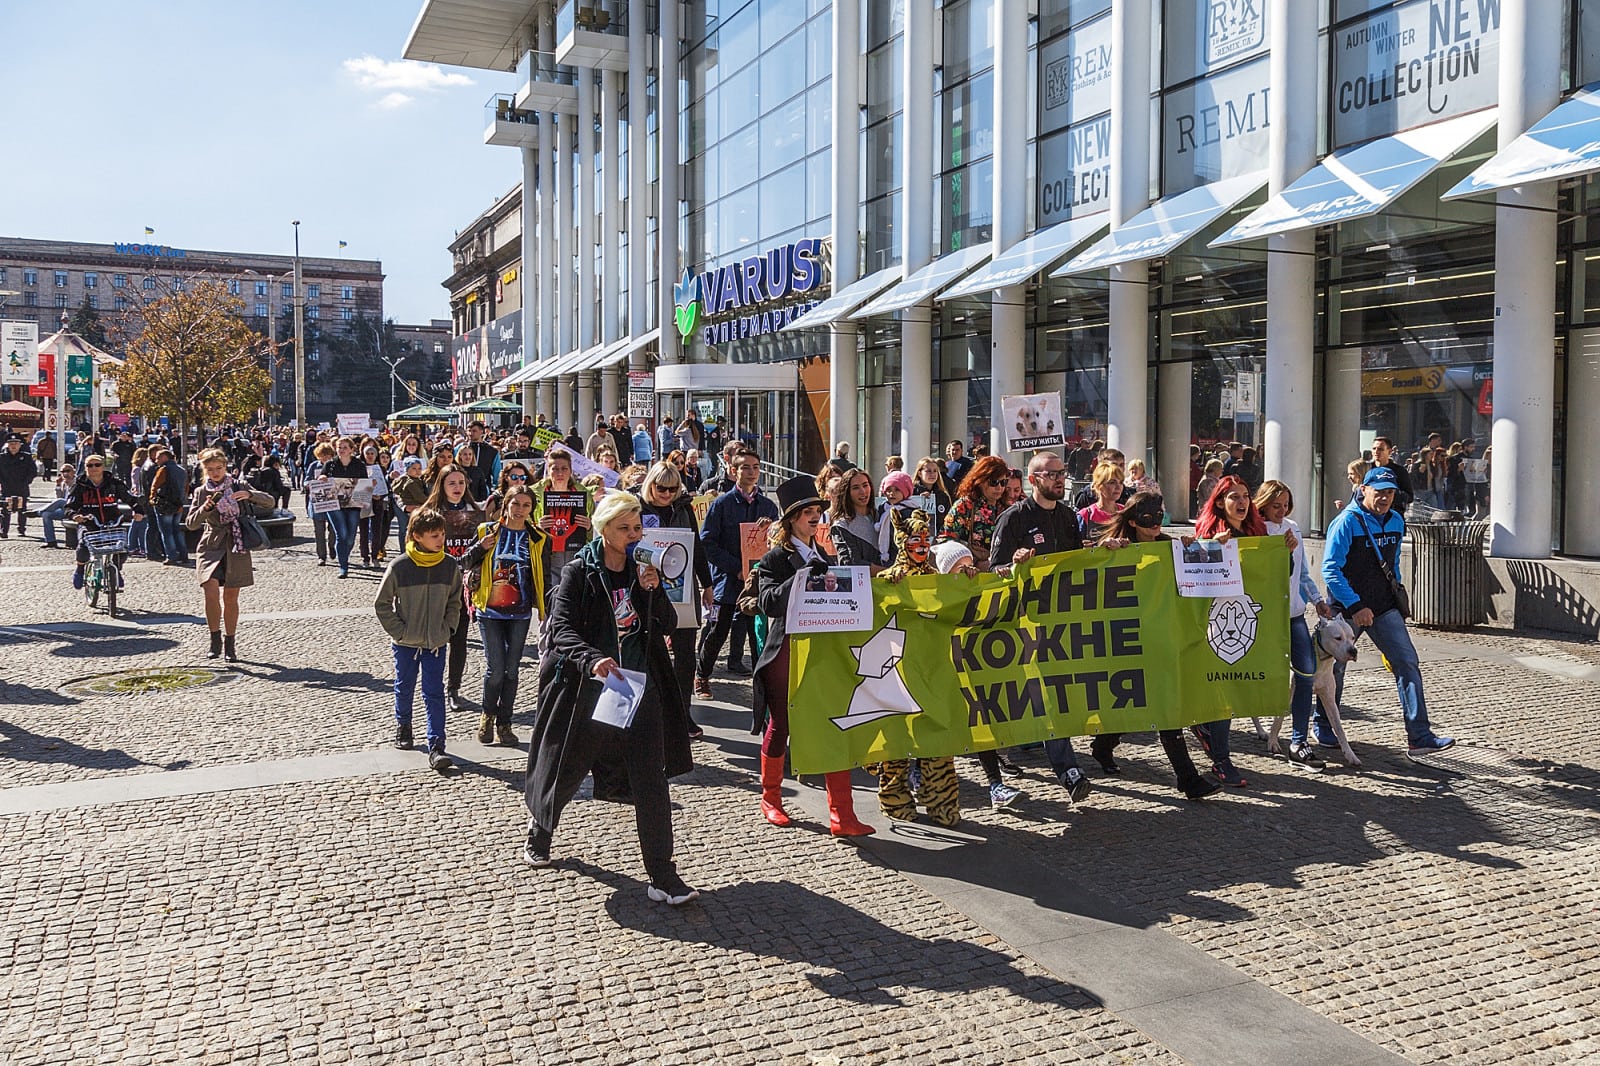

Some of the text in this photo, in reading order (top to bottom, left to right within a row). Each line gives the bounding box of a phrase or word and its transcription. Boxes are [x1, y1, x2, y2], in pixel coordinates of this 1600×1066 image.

[1346, 21, 1388, 50] AUTUMN
[1375, 28, 1416, 56] WINTER
[1339, 38, 1480, 114] COLLECTION
[701, 239, 821, 316] VARUS
[1021, 439, 1038, 447] ХОЧУ
[955, 565, 1139, 629] ЦІННЕ
[798, 618, 855, 627] БЕЗНАКАЗАННО
[951, 618, 1143, 672] КОЖНЕ
[1206, 671, 1266, 682] UANIMALS
[960, 669, 1147, 727] ЖИТТЯ
